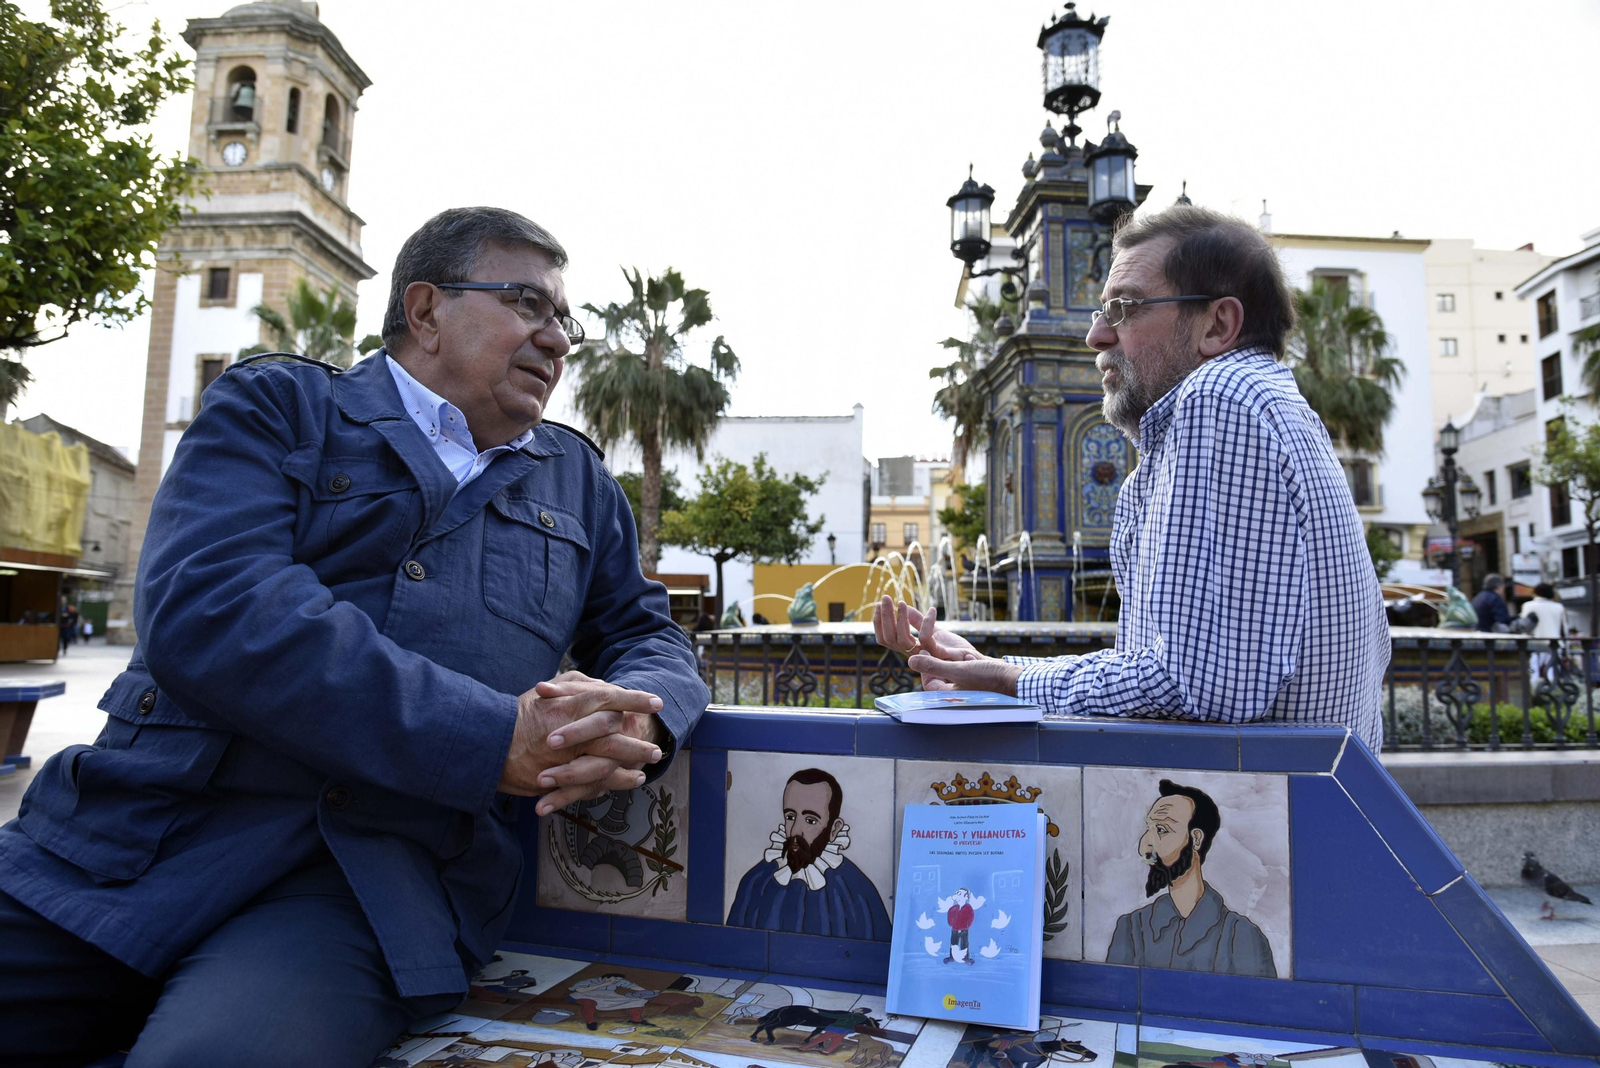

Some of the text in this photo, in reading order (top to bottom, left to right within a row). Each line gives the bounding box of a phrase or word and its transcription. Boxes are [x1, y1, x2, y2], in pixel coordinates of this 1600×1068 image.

[911, 829, 1026, 839] PALACIETAS Y VILLANUETAS
[948, 998, 981, 1008] ImagenTa
